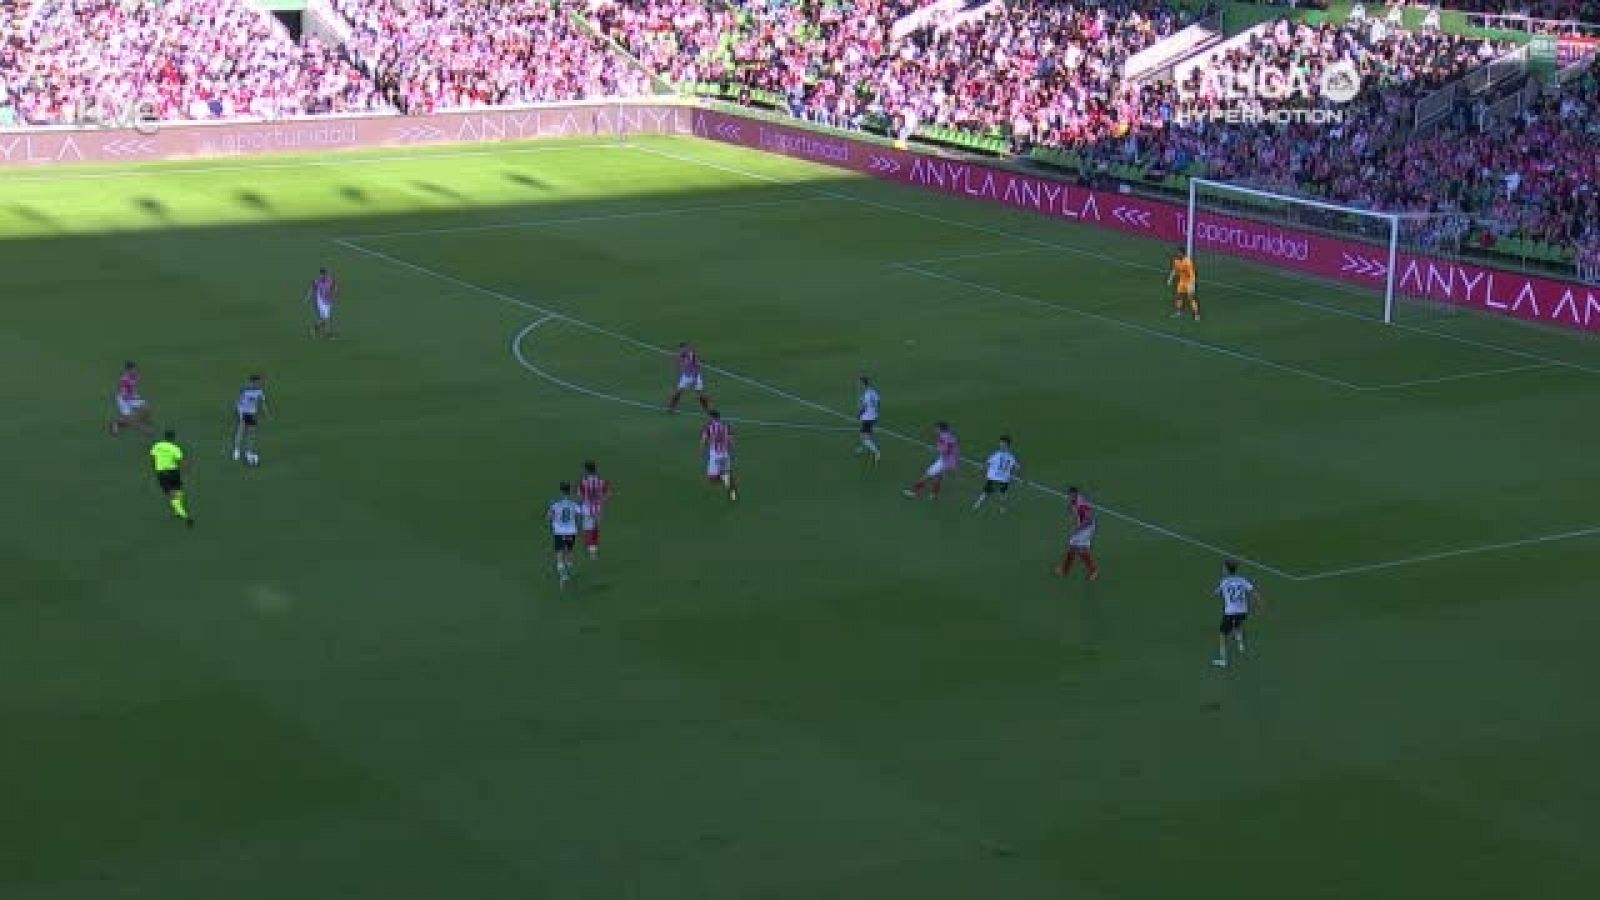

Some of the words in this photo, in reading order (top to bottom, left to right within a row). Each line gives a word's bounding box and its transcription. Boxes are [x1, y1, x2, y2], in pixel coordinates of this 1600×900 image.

[456, 111, 581, 140] ANYLA
[909, 157, 997, 199] ANYLA
[1004, 178, 1102, 222] ANYLA
[1197, 222, 1310, 261] oportunidad
[1399, 259, 1541, 317] ANYLA
